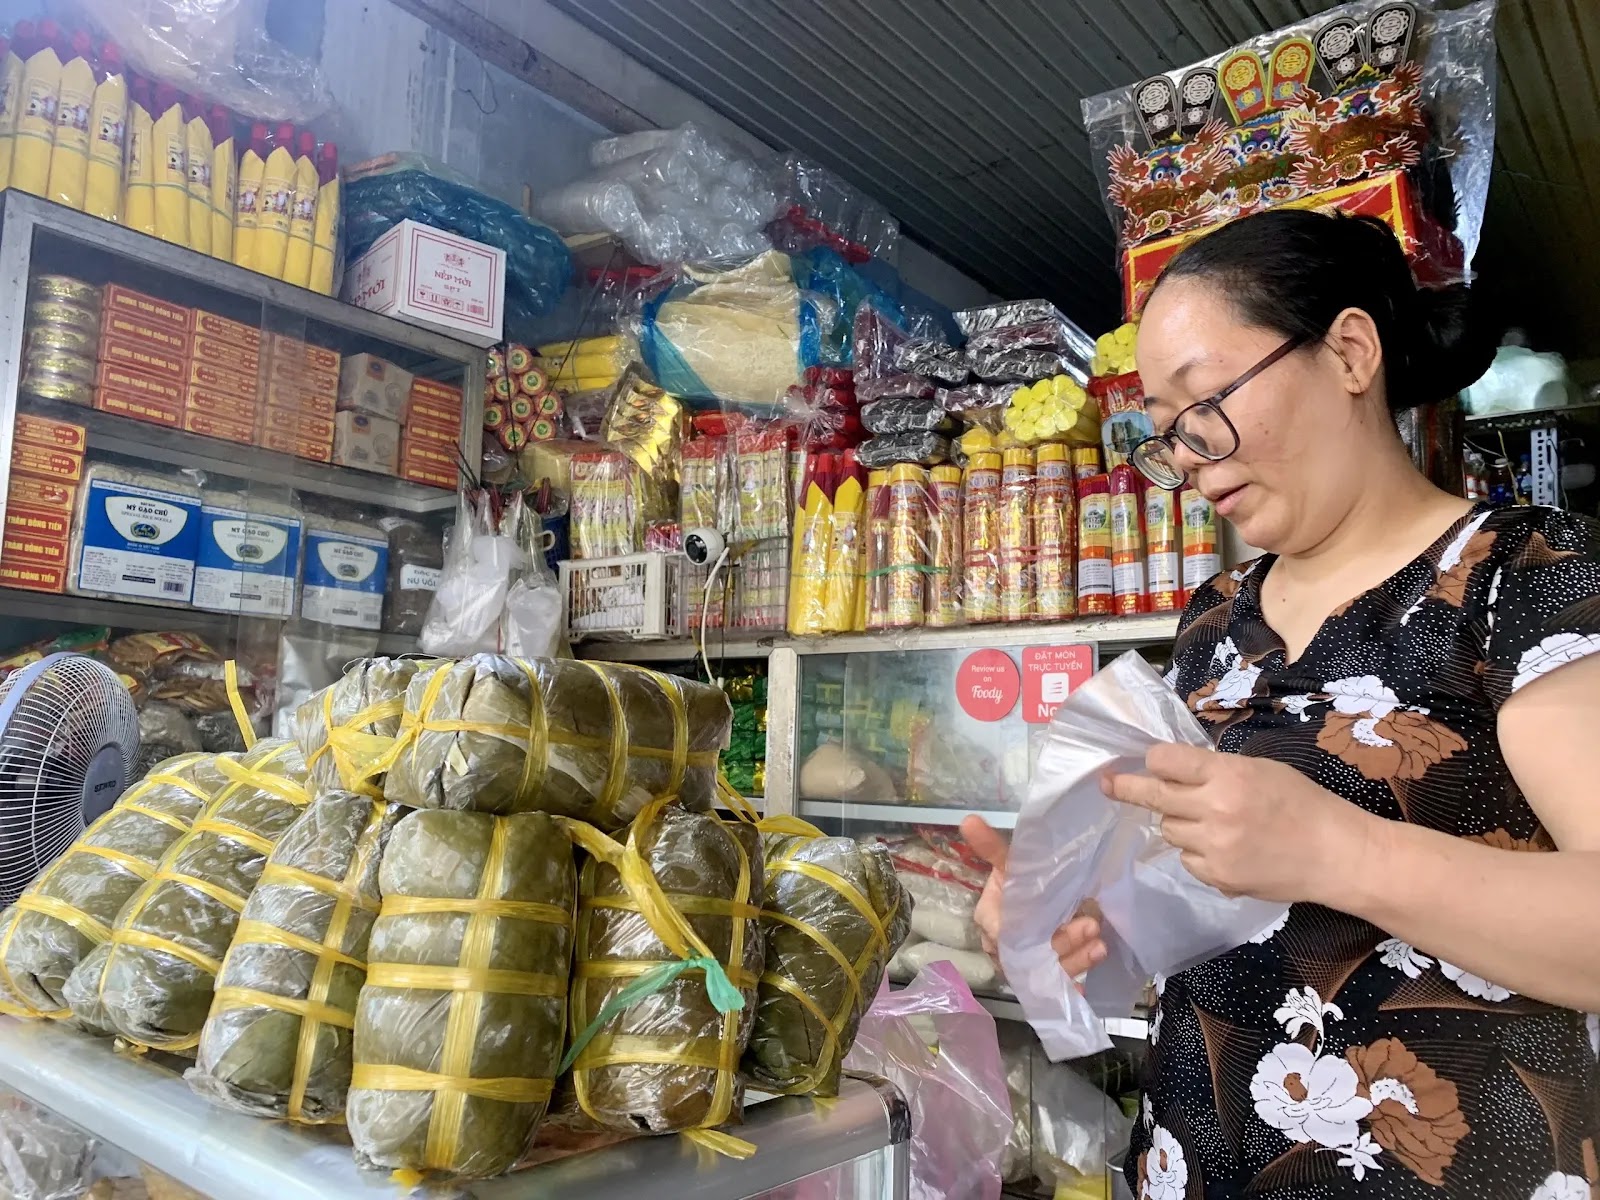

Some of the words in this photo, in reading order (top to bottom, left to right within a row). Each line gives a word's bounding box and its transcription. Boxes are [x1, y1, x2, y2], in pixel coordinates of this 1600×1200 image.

[1035, 651, 1052, 660] ĐẶT
[1054, 650, 1076, 660] MÓN
[971, 665, 995, 673] Review
[1028, 662, 1051, 672] TRỰC
[1054, 660, 1083, 671] TUYẾN
[972, 685, 1003, 705] Foody
